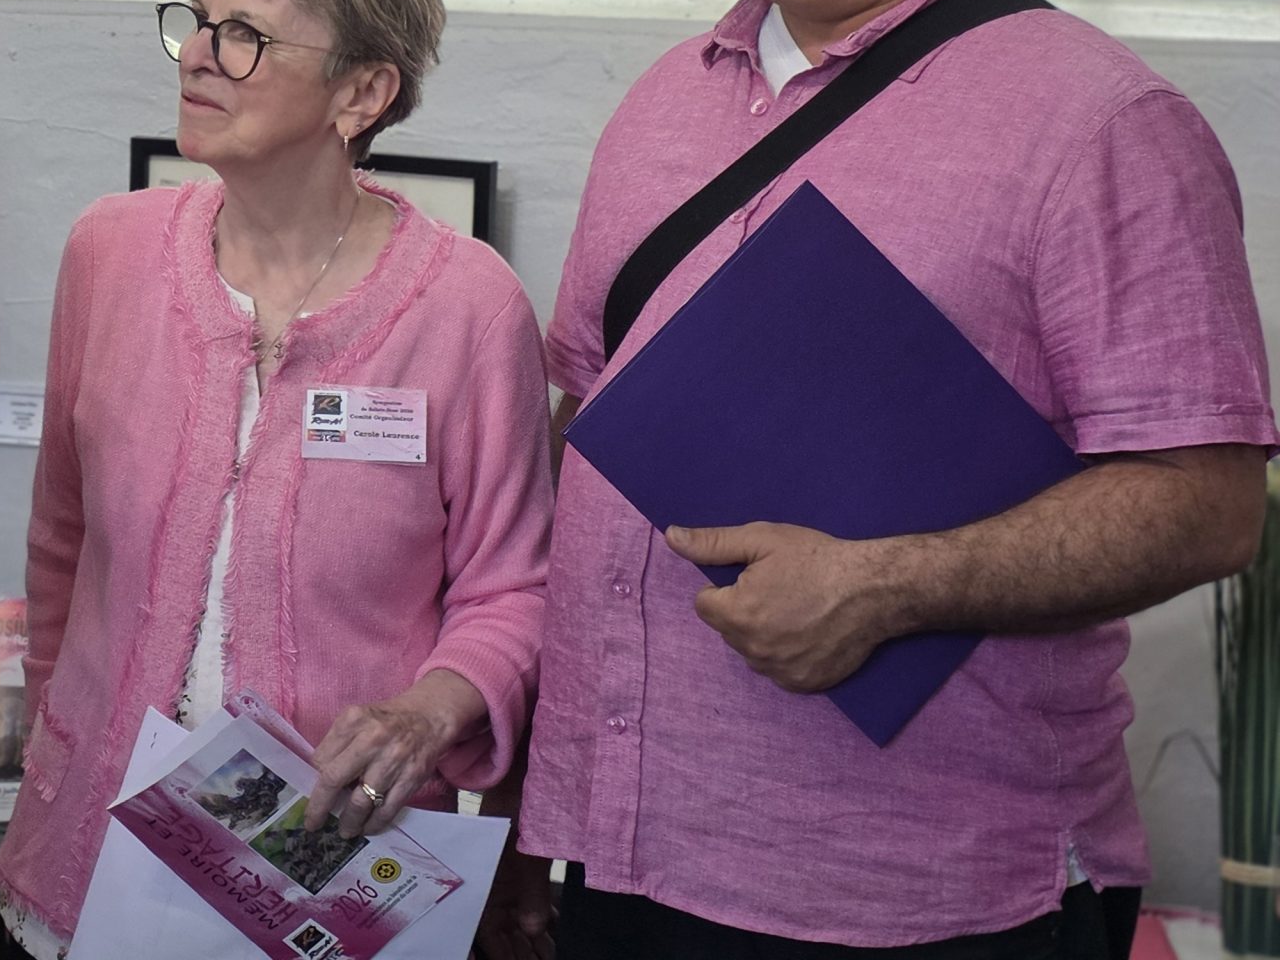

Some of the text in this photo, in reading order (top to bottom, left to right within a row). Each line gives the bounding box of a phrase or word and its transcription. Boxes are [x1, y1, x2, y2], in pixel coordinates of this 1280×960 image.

[353, 430, 420, 440] Carole Laurence
[331, 879, 378, 922] 2026
